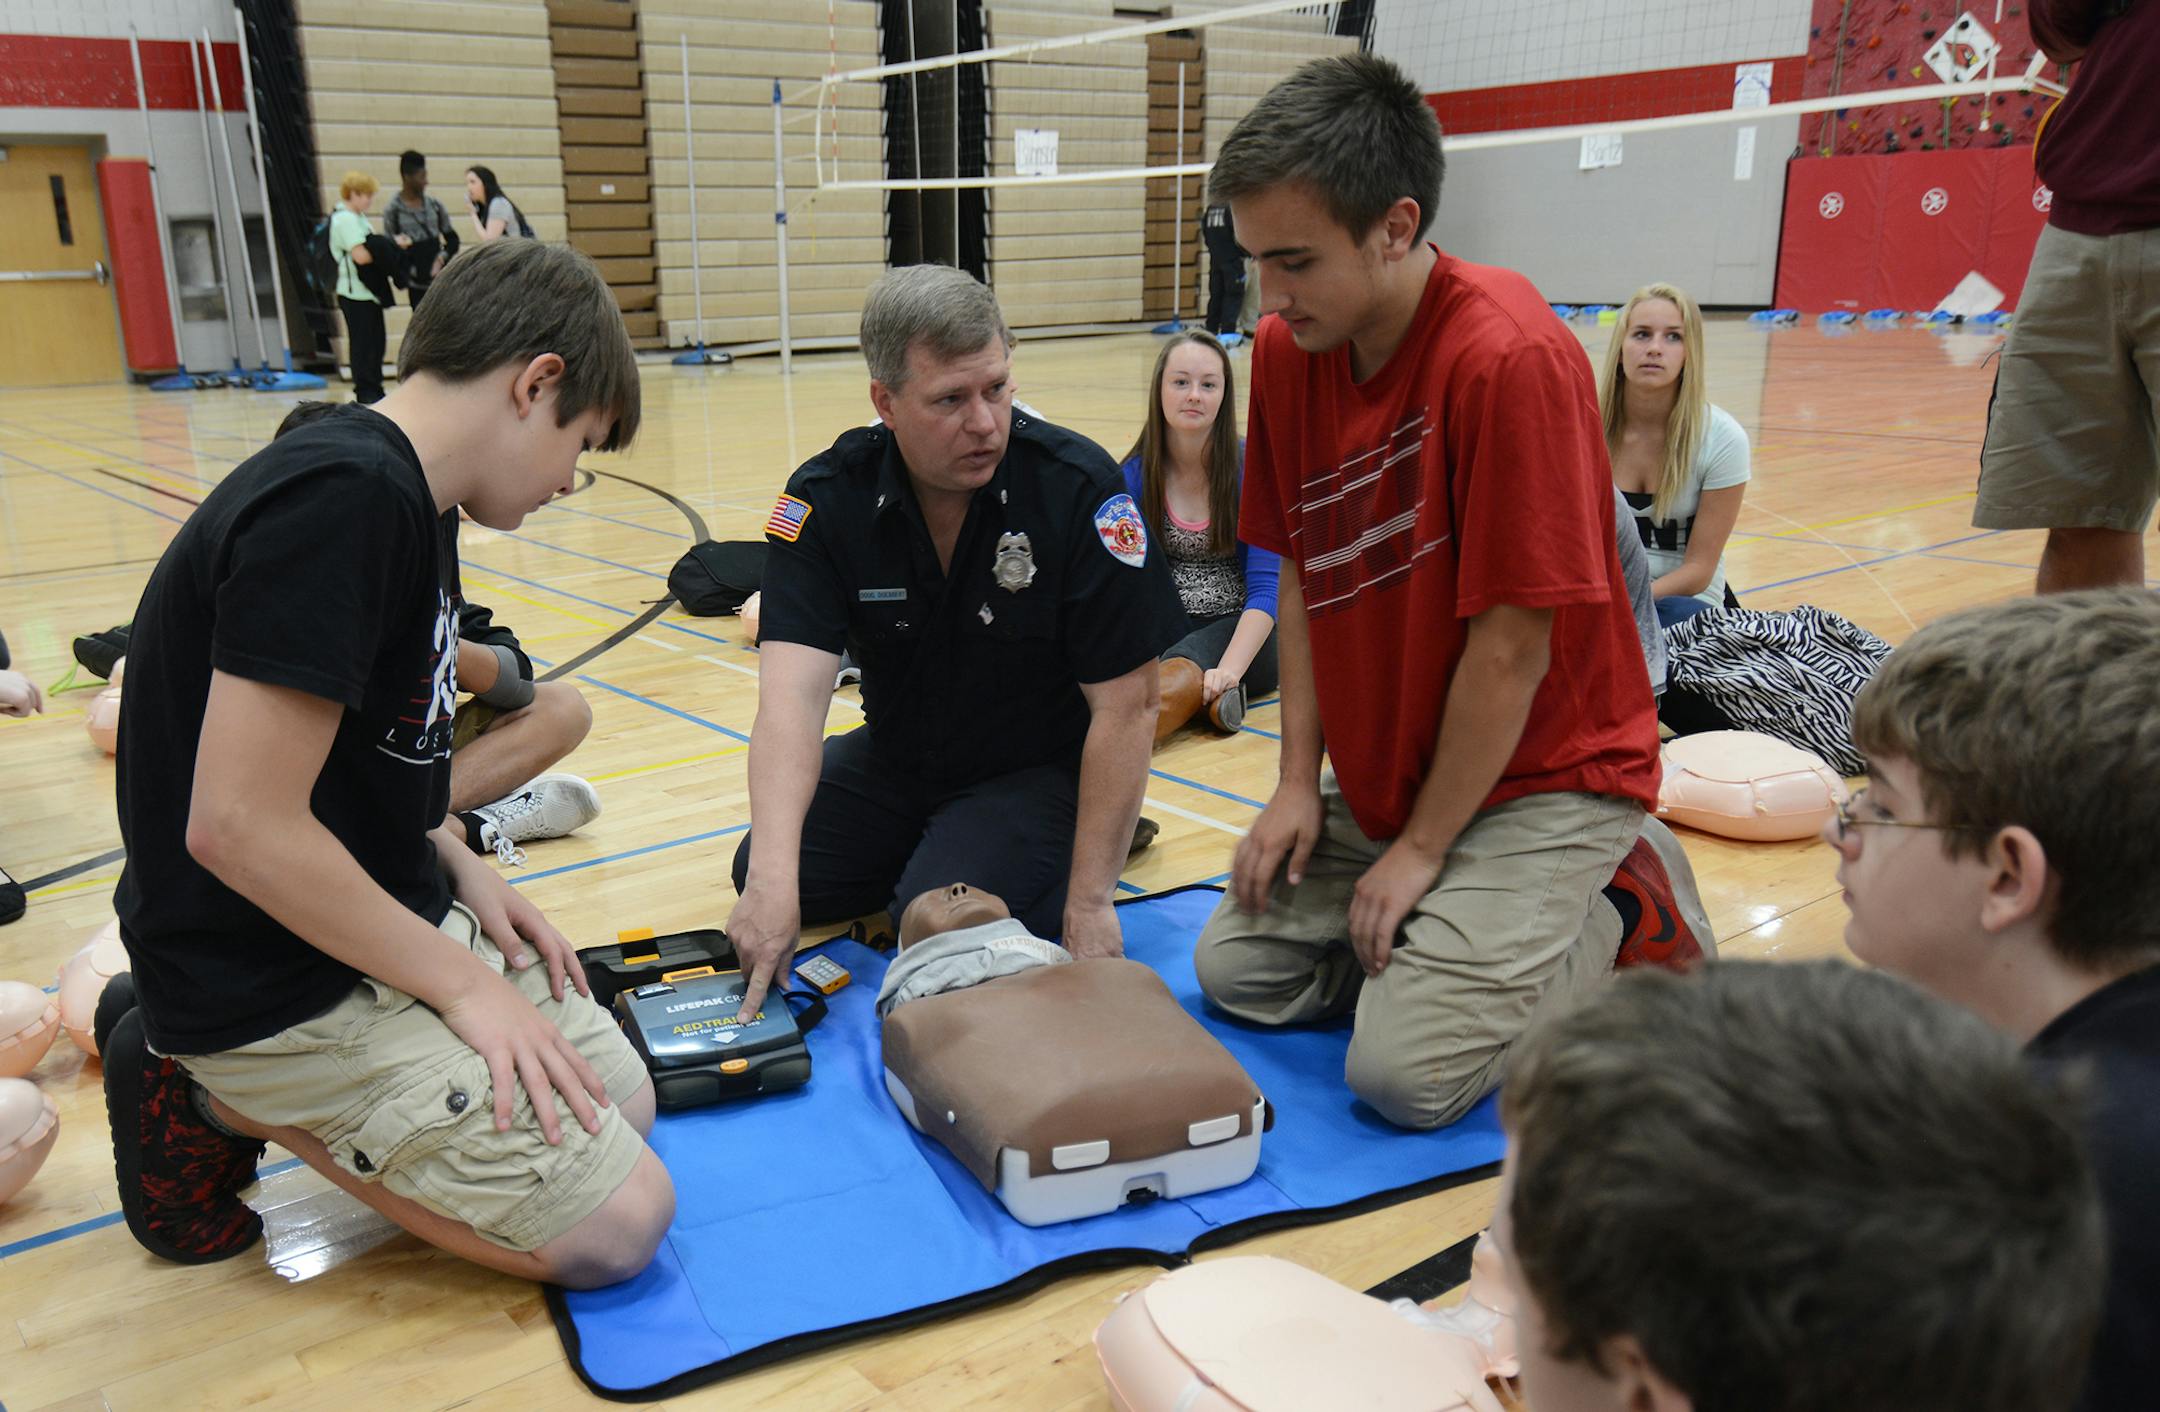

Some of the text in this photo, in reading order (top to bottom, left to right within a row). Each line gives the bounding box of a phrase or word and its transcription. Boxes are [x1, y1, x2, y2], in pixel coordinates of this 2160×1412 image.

[665, 997, 724, 1014] LIFEPAK
[673, 1012, 766, 1035] AED TRAIR
